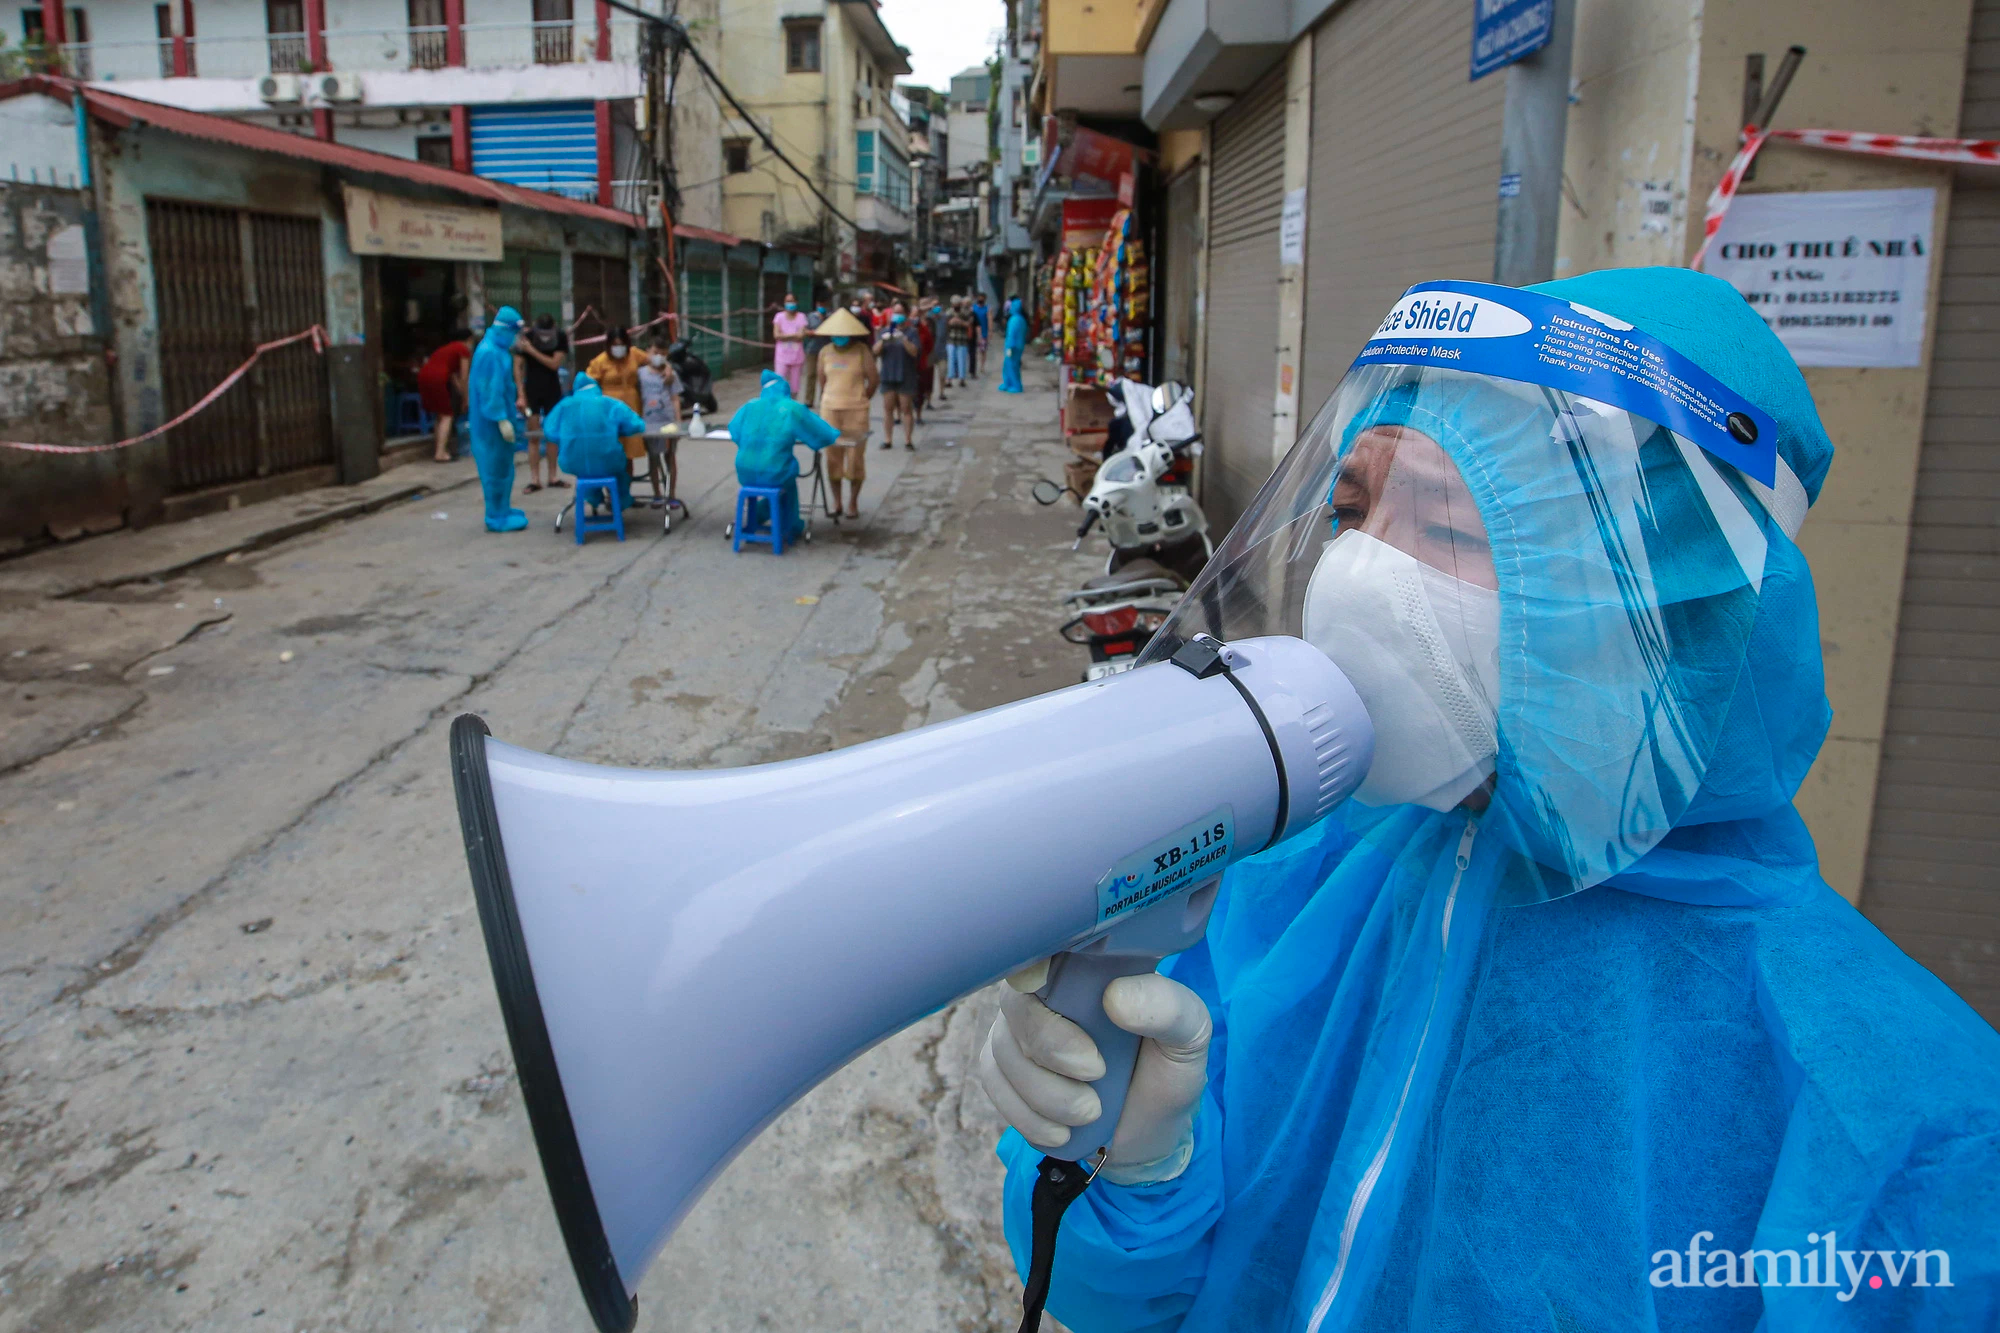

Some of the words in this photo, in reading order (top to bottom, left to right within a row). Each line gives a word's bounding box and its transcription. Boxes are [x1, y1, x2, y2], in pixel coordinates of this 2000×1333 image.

[1720, 242, 1776, 260] CHO
[1786, 235, 1860, 258] THUÊ
[1868, 234, 1925, 257] NHÀ
[1378, 310, 1404, 333] ace
[1404, 300, 1478, 333] Shield
[1552, 315, 1621, 344] Instructions
[1623, 339, 1639, 352] for
[1641, 347, 1664, 365] Use:
[1384, 344, 1428, 357] Protective
[1430, 345, 1462, 360] Mask
[1538, 353, 1566, 367] Thank
[1568, 362, 1586, 374] you
[1544, 334, 1566, 346] from
[1567, 340, 1593, 356] being
[1595, 350, 1639, 371] scratched
[1640, 368, 1666, 386] during
[1667, 381, 1717, 418] transportation
[1549, 325, 1575, 339] There
[1577, 333, 1585, 342] is
[1595, 342, 1638, 362] protective
[1640, 358, 1658, 372] from
[1660, 369, 1668, 377] to
[1669, 375, 1695, 394] protect
[1696, 391, 1708, 403] the
[1708, 399, 1724, 414] face
[1540, 343, 1573, 358] Please
[1574, 354, 1610, 370] remove
[1611, 365, 1626, 376] the
[1627, 372, 1669, 396] protective
[1670, 392, 1688, 408] from
[1688, 403, 1712, 423] before
[1713, 420, 1728, 433] use
[1154, 822, 1225, 875] XB-11S
[1105, 886, 1151, 918] PORTABLE
[1151, 866, 1188, 894] MUSICAL
[1189, 844, 1227, 874] SPEAKER
